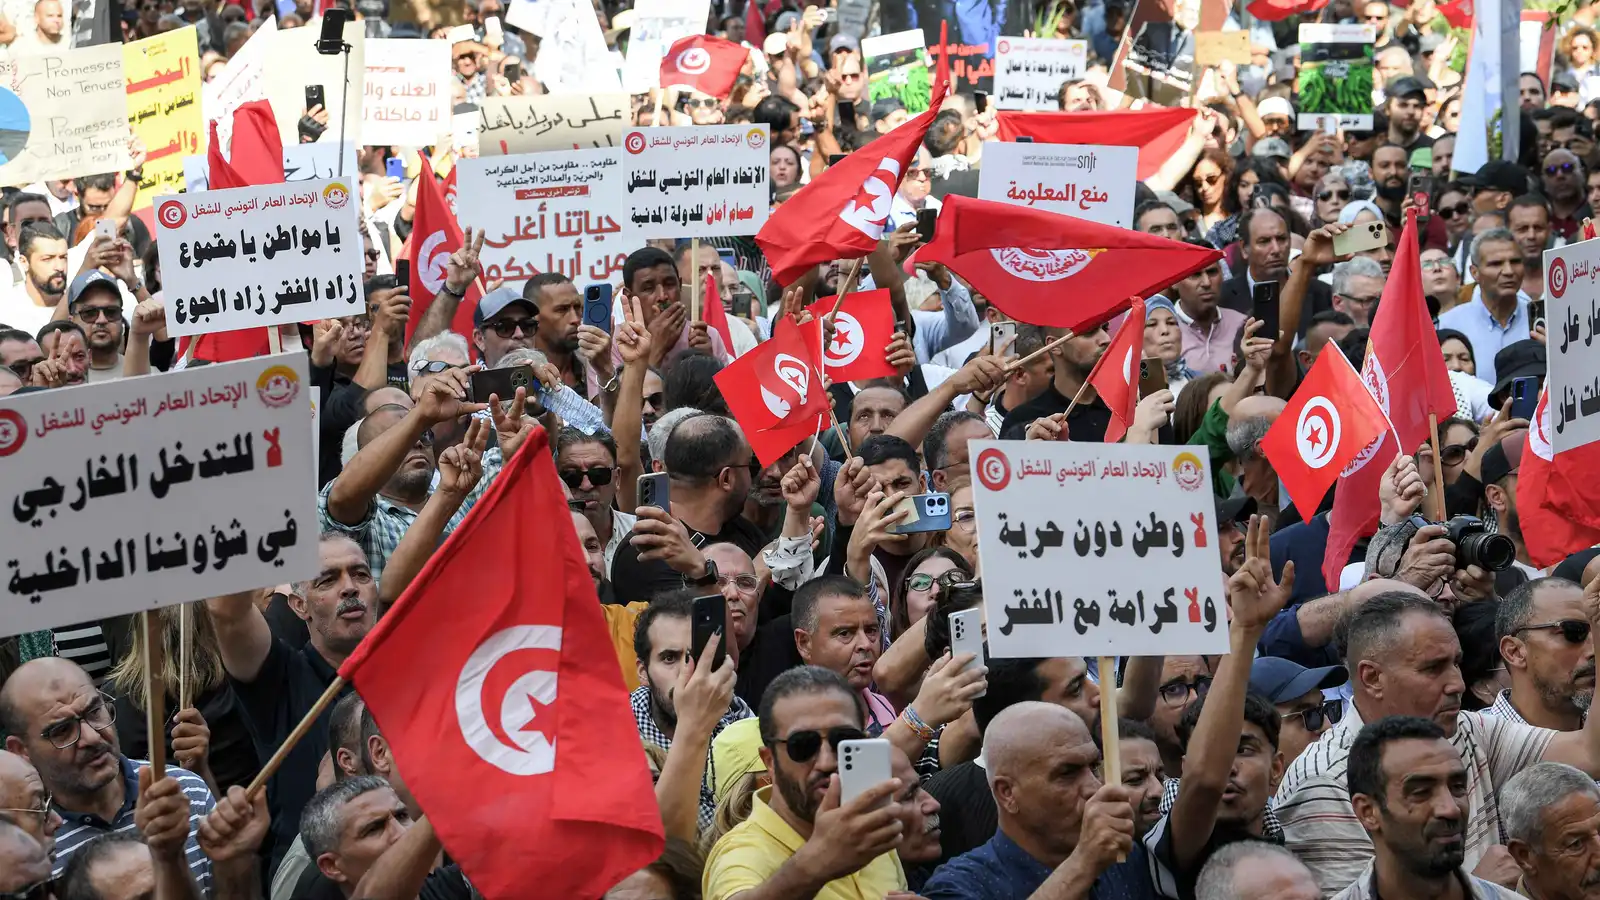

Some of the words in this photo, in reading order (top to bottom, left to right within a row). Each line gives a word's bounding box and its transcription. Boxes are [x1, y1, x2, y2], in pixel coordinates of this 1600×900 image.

[42, 57, 121, 78] Promesses
[46, 85, 70, 98] Non
[74, 78, 122, 94] Tenues
[567, 97, 622, 129] على
[48, 116, 125, 138] Promesses
[700, 134, 719, 146] العام
[54, 142, 82, 155] Non
[650, 136, 671, 148] للشغل
[673, 136, 698, 150] التونسي
[485, 165, 518, 176] الكرامة
[538, 163, 550, 173] من
[552, 161, 578, 172] مقاومة
[1077, 152, 1097, 173] snjt
[540, 173, 571, 184] والعدالة
[628, 170, 656, 193] للشغل
[659, 168, 704, 195] التونسي
[706, 168, 730, 192] العام
[733, 166, 765, 188] الإتحاد
[262, 196, 286, 211] العام
[289, 192, 318, 210] الإتحاد
[1007, 180, 1076, 206] المعلومة
[1079, 186, 1108, 210] منع
[192, 203, 221, 219] للشغل
[224, 198, 258, 220] التونسي
[631, 204, 667, 228] المدنية
[670, 203, 703, 226] للدولة
[706, 199, 726, 225] أمان
[730, 202, 754, 226] صمام
[484, 201, 548, 248] أغلى
[554, 210, 621, 242] حياتنا
[179, 232, 237, 268] مقموع
[263, 224, 322, 259] مواطن
[590, 253, 628, 280] من
[1570, 260, 1588, 284] للشغل
[234, 284, 266, 315] زاد
[270, 276, 318, 314] الفقر
[325, 274, 358, 304] زاد
[175, 287, 226, 324] الجوع
[1560, 304, 1580, 354] عار
[154, 390, 194, 418] العام
[199, 382, 248, 409] الإتحاد
[1556, 384, 1576, 434] نار
[35, 408, 85, 438] للشغل
[91, 398, 147, 436] التونسي
[263, 426, 282, 468] لا
[150, 431, 255, 500] للتدخل
[1017, 459, 1052, 480] للشغل
[1056, 460, 1096, 487] التونسي
[1100, 461, 1128, 480] العام
[1132, 461, 1167, 484] الإتحاد
[12, 452, 138, 528] الخارجي
[257, 509, 298, 568] في
[998, 512, 1064, 559] حرية
[1073, 518, 1124, 558] دون
[1132, 511, 1184, 558] وطن
[1190, 512, 1208, 548] لا
[144, 518, 248, 574] شؤوننا
[8, 538, 136, 604] الداخلية
[999, 588, 1064, 636] الفقر
[1073, 597, 1100, 635] مع
[1108, 587, 1178, 634] كرامة
